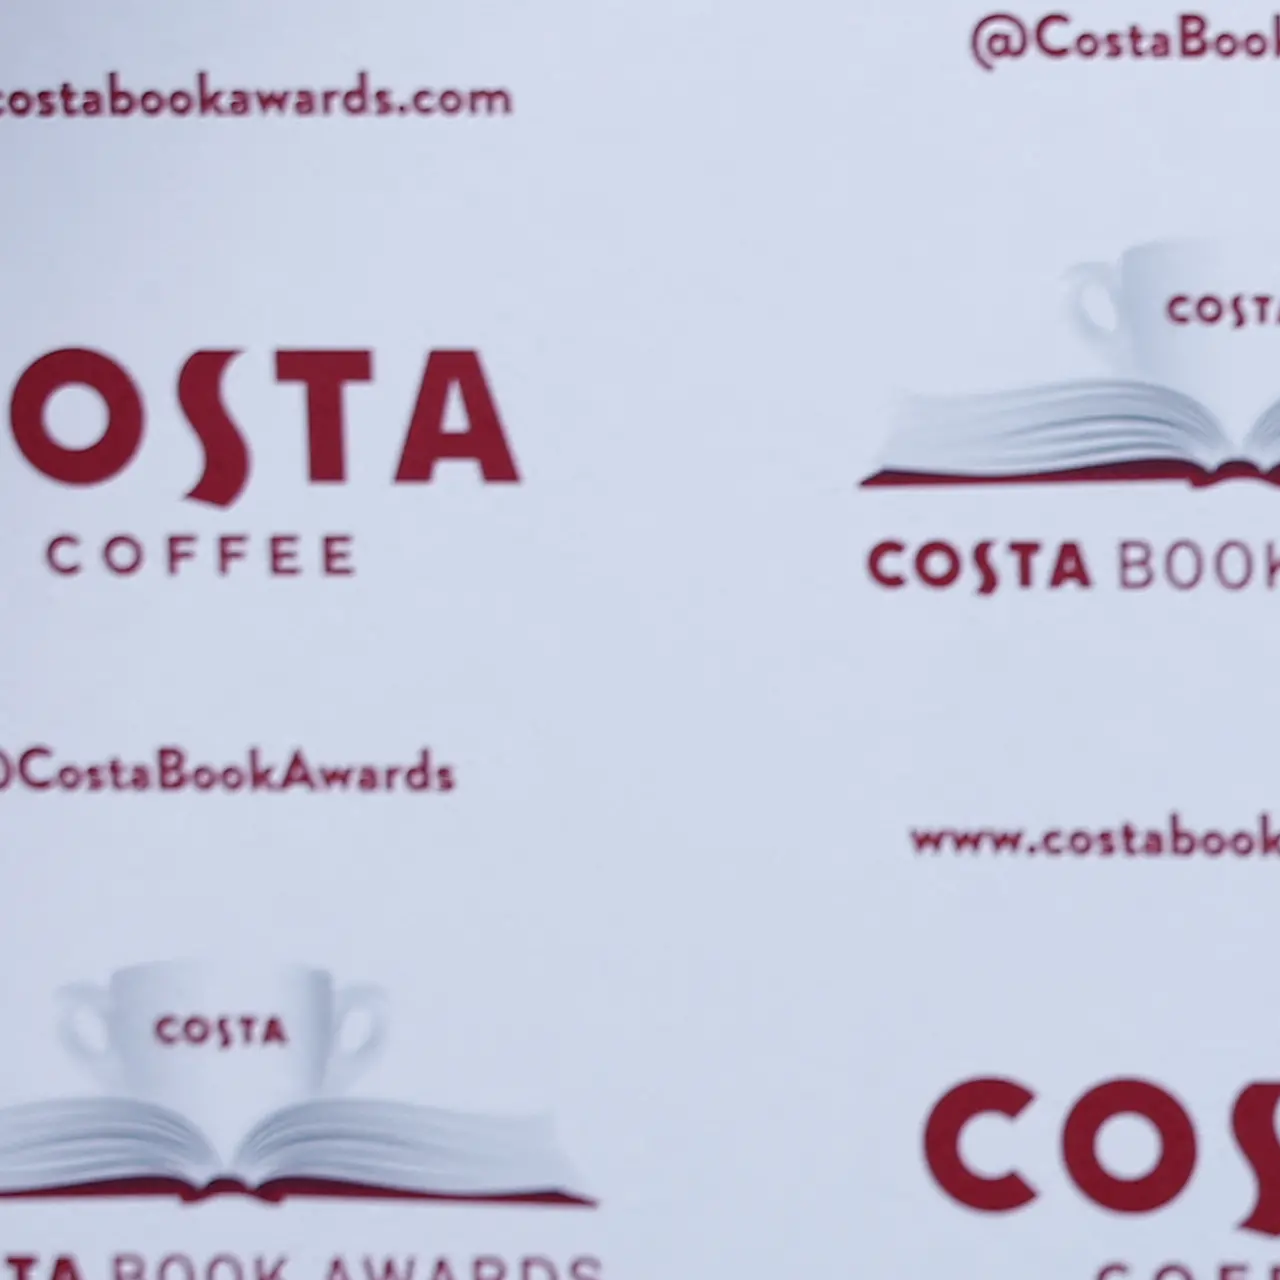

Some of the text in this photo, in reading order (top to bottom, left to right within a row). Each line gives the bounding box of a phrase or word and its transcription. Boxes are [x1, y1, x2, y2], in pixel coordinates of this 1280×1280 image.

[46, 534, 353, 576] COFFEE
[867, 540, 1091, 595] COSTA
[0, 746, 455, 792] CostaBookAwards
[155, 1016, 287, 1048] COSTA
